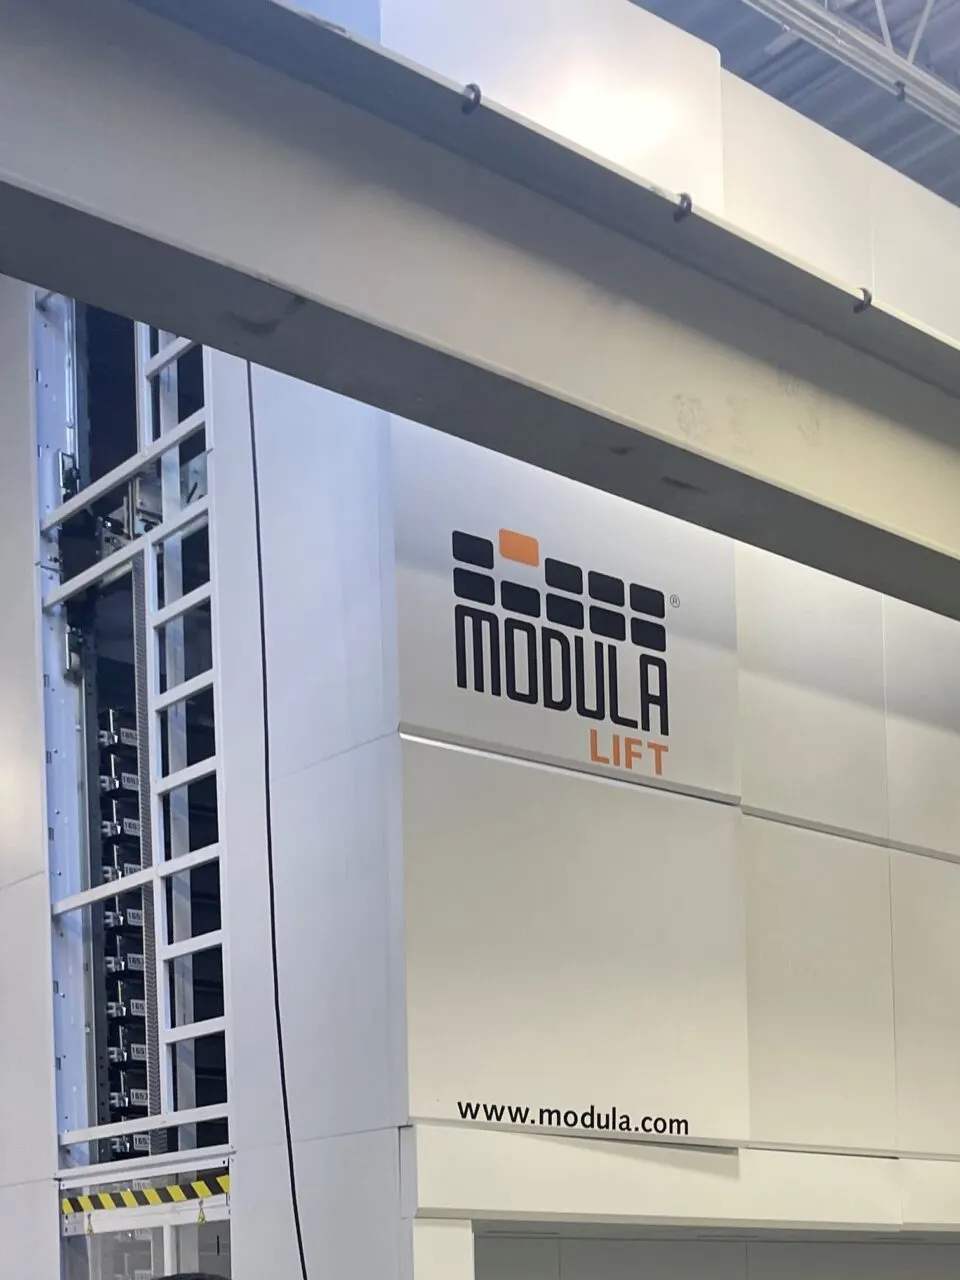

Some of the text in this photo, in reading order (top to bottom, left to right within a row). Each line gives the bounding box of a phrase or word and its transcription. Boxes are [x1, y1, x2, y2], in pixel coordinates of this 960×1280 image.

[454, 604, 669, 736] MODULA
[590, 729, 669, 776] LIFT
[457, 1101, 689, 1135] www.modula.com
